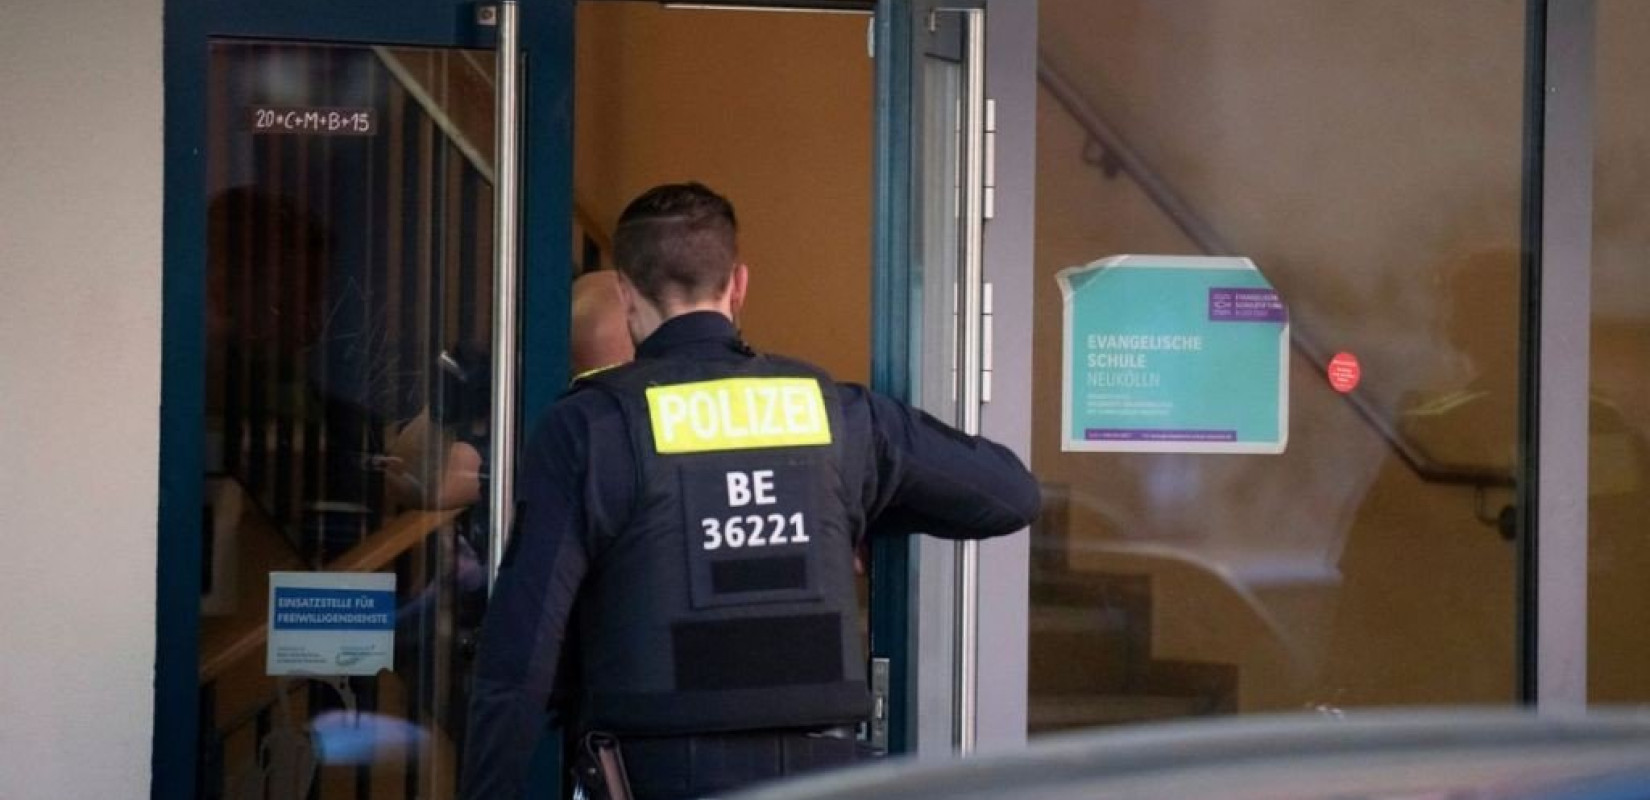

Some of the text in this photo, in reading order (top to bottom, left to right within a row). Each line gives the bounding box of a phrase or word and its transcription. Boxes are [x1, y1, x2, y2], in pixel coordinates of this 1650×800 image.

[1087, 334, 1202, 351] EVANGELISCHE
[1087, 353, 1146, 368] SCHULE
[1087, 370, 1160, 387] NEUKÖLLN
[658, 384, 821, 442] POLIZEI
[726, 470, 777, 507] BE
[701, 512, 810, 550] 36221
[279, 595, 374, 608] EINSATZSTELLE FÜR
